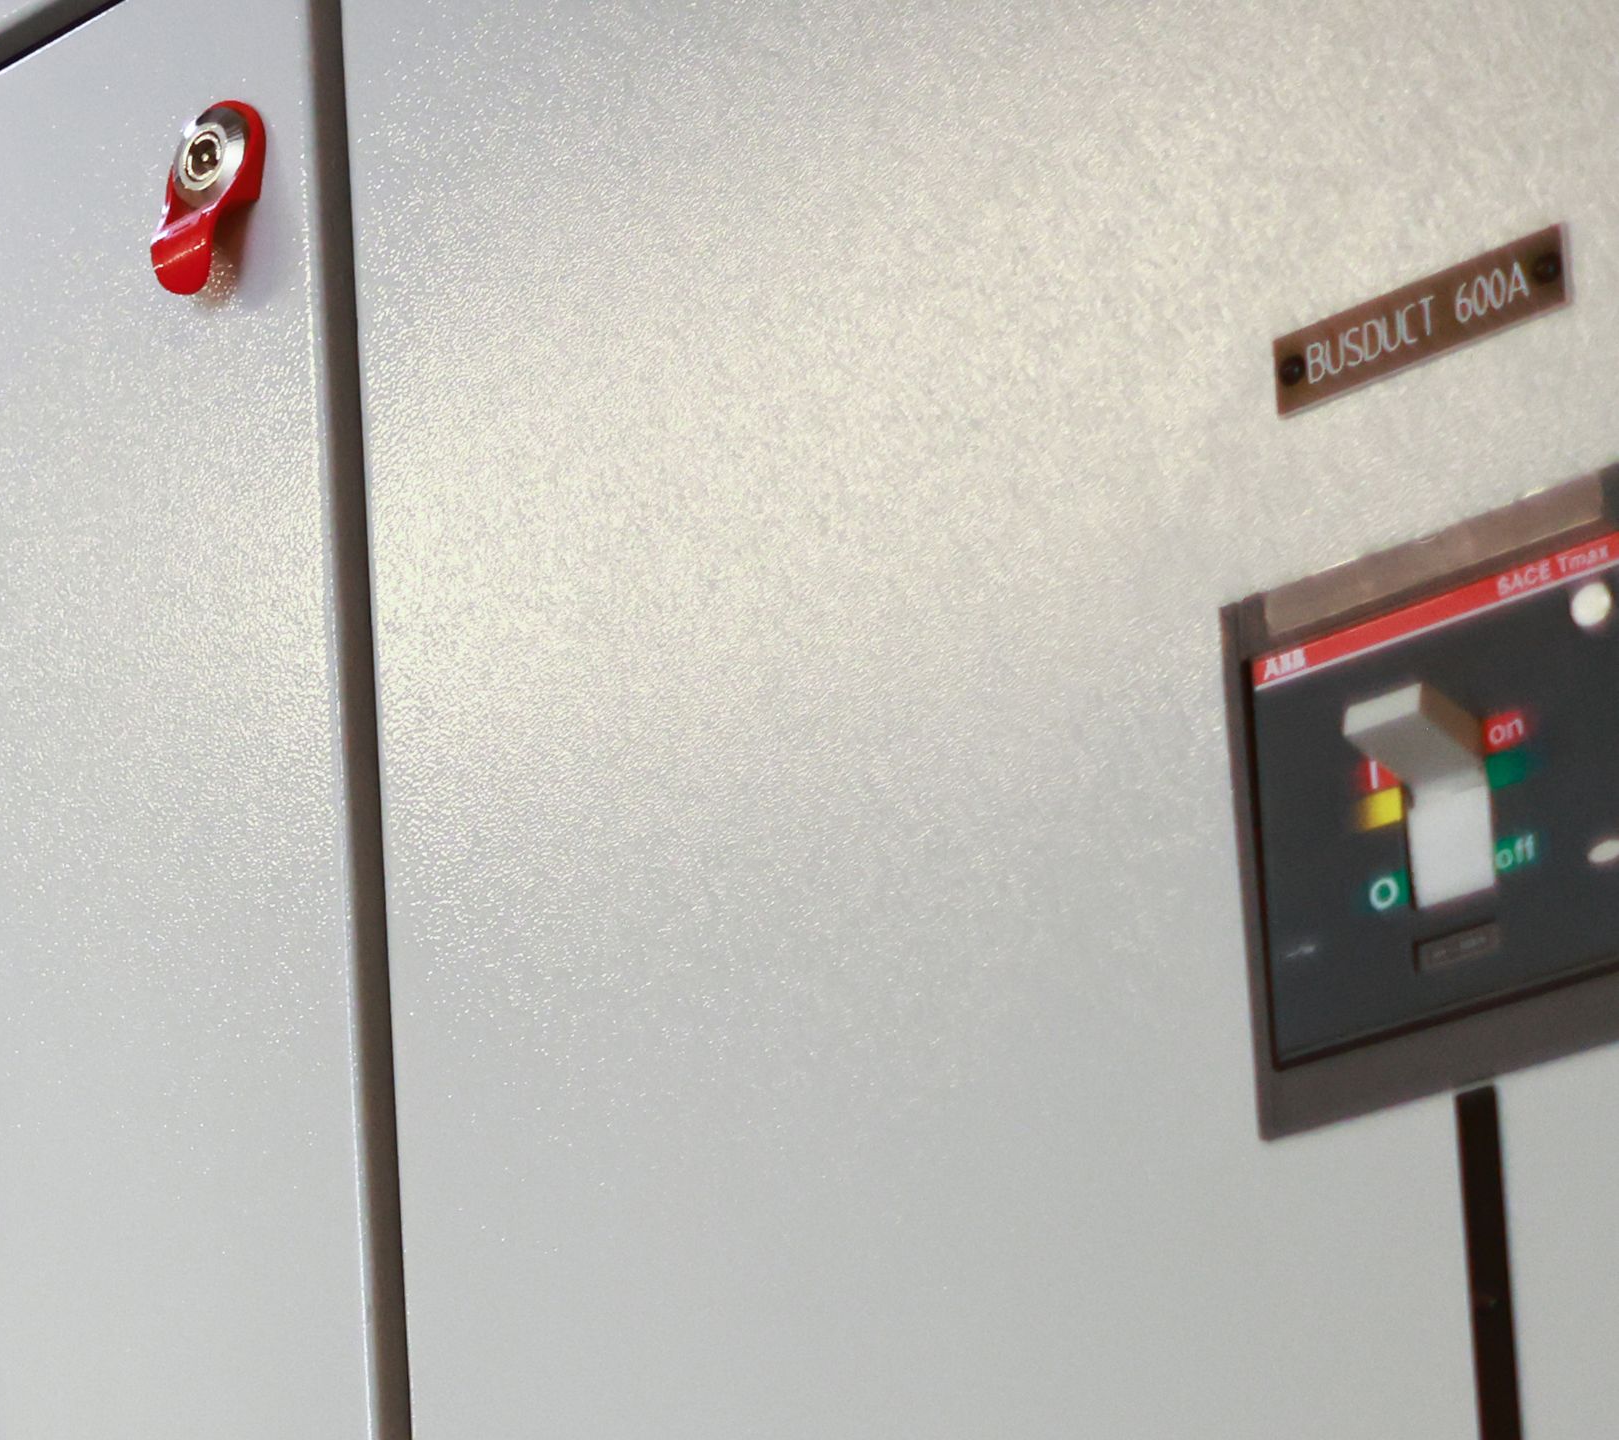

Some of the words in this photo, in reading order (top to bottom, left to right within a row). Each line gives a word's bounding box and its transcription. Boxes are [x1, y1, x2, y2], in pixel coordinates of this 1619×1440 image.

[1305, 295, 1436, 384] BUSDUCT
[1454, 261, 1530, 324] 600A
[1498, 559, 1551, 597] SACE
[1489, 717, 1525, 745] on
[1496, 833, 1537, 870] off
